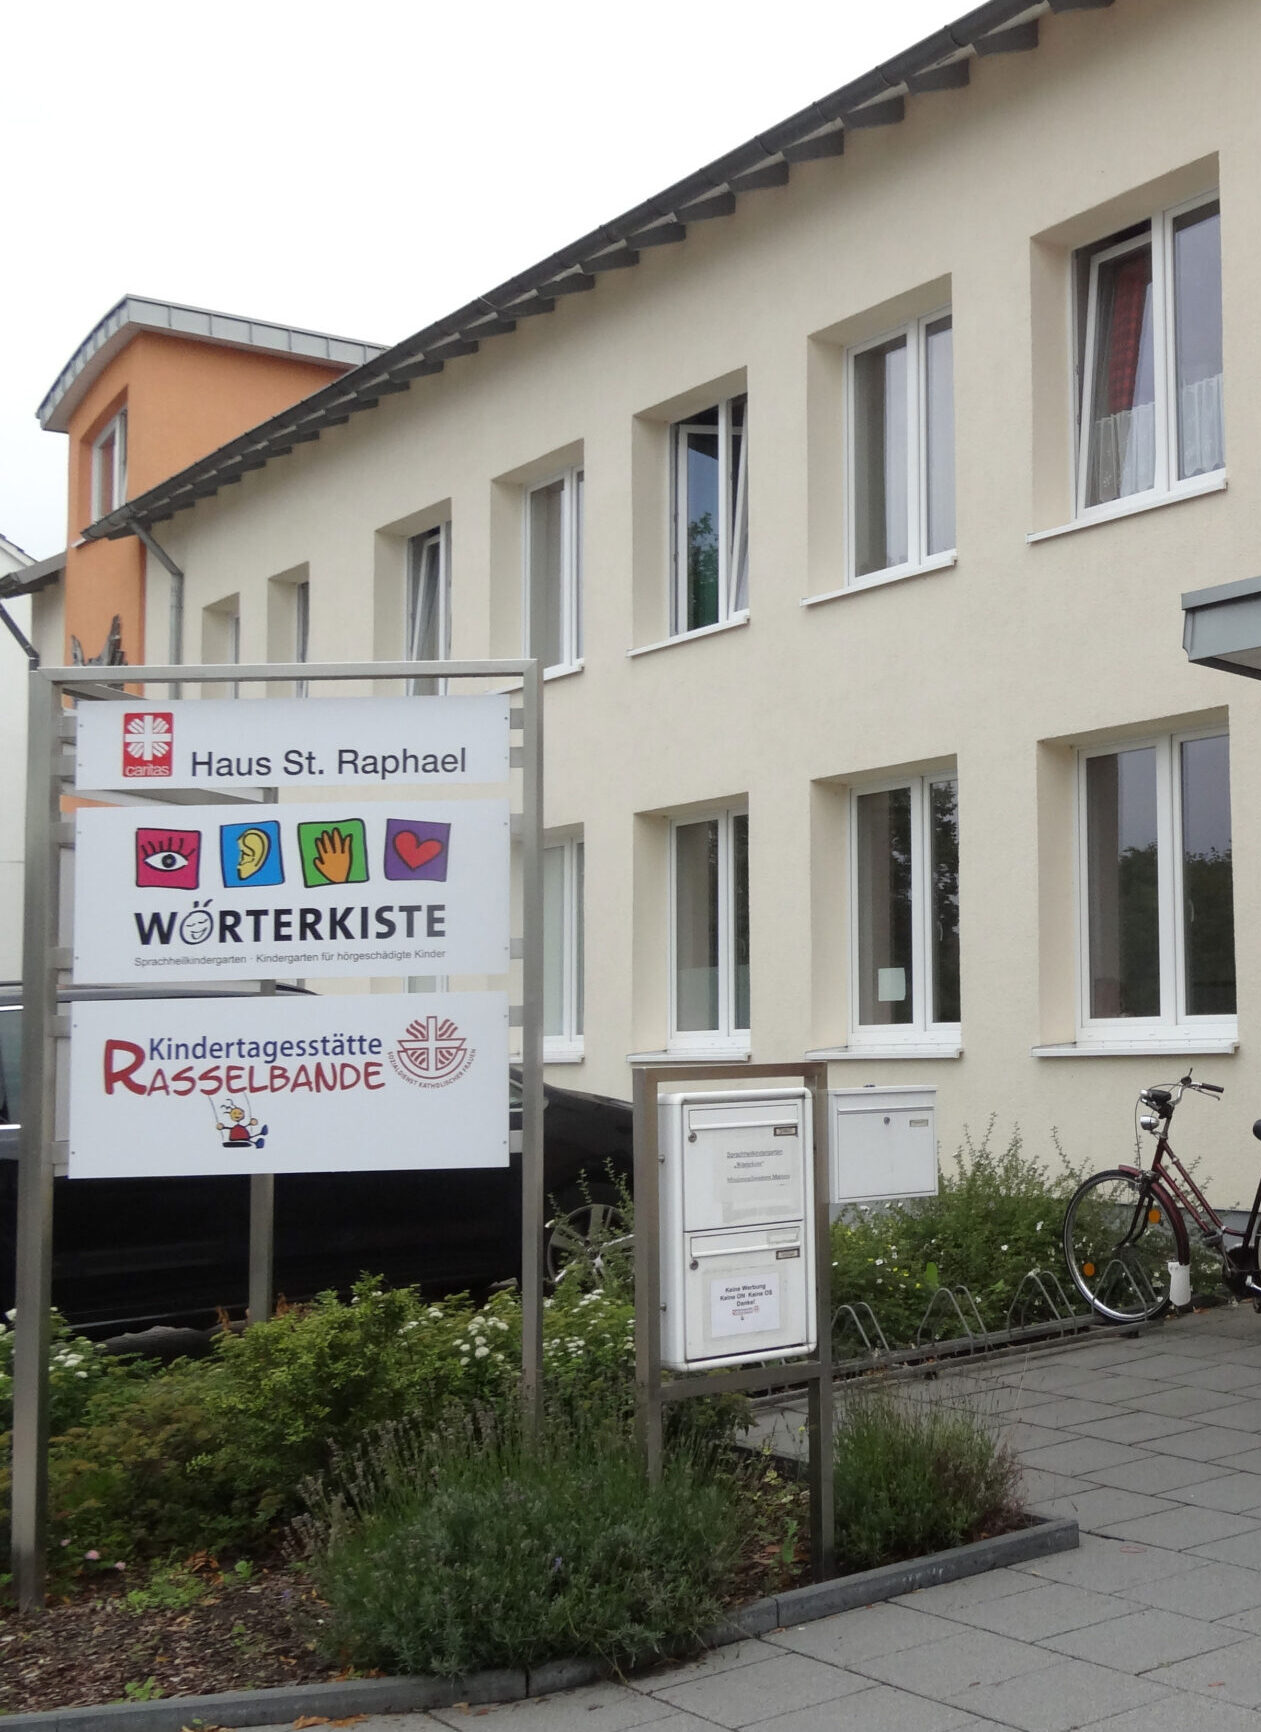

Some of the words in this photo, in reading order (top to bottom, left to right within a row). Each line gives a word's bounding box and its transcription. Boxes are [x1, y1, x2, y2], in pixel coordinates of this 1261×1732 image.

[126, 763, 170, 777] caritas
[191, 750, 272, 777] Haus
[283, 749, 324, 775] St.
[337, 747, 467, 779] Raphael
[134, 899, 447, 946] WÖRTERKISTE
[134, 954, 247, 967] Sprachheilkindergarten
[256, 951, 319, 964] Kindergarten
[321, 950, 334, 962] für
[337, 948, 412, 963] hörgeschädigte
[414, 948, 446, 959] Kinder
[149, 1034, 383, 1065] Kindertagesstätte
[103, 1039, 386, 1097] RASSELBANDE
[419, 1071, 464, 1089] KATHOLISCHER
[462, 1048, 477, 1073] FRAUEN
